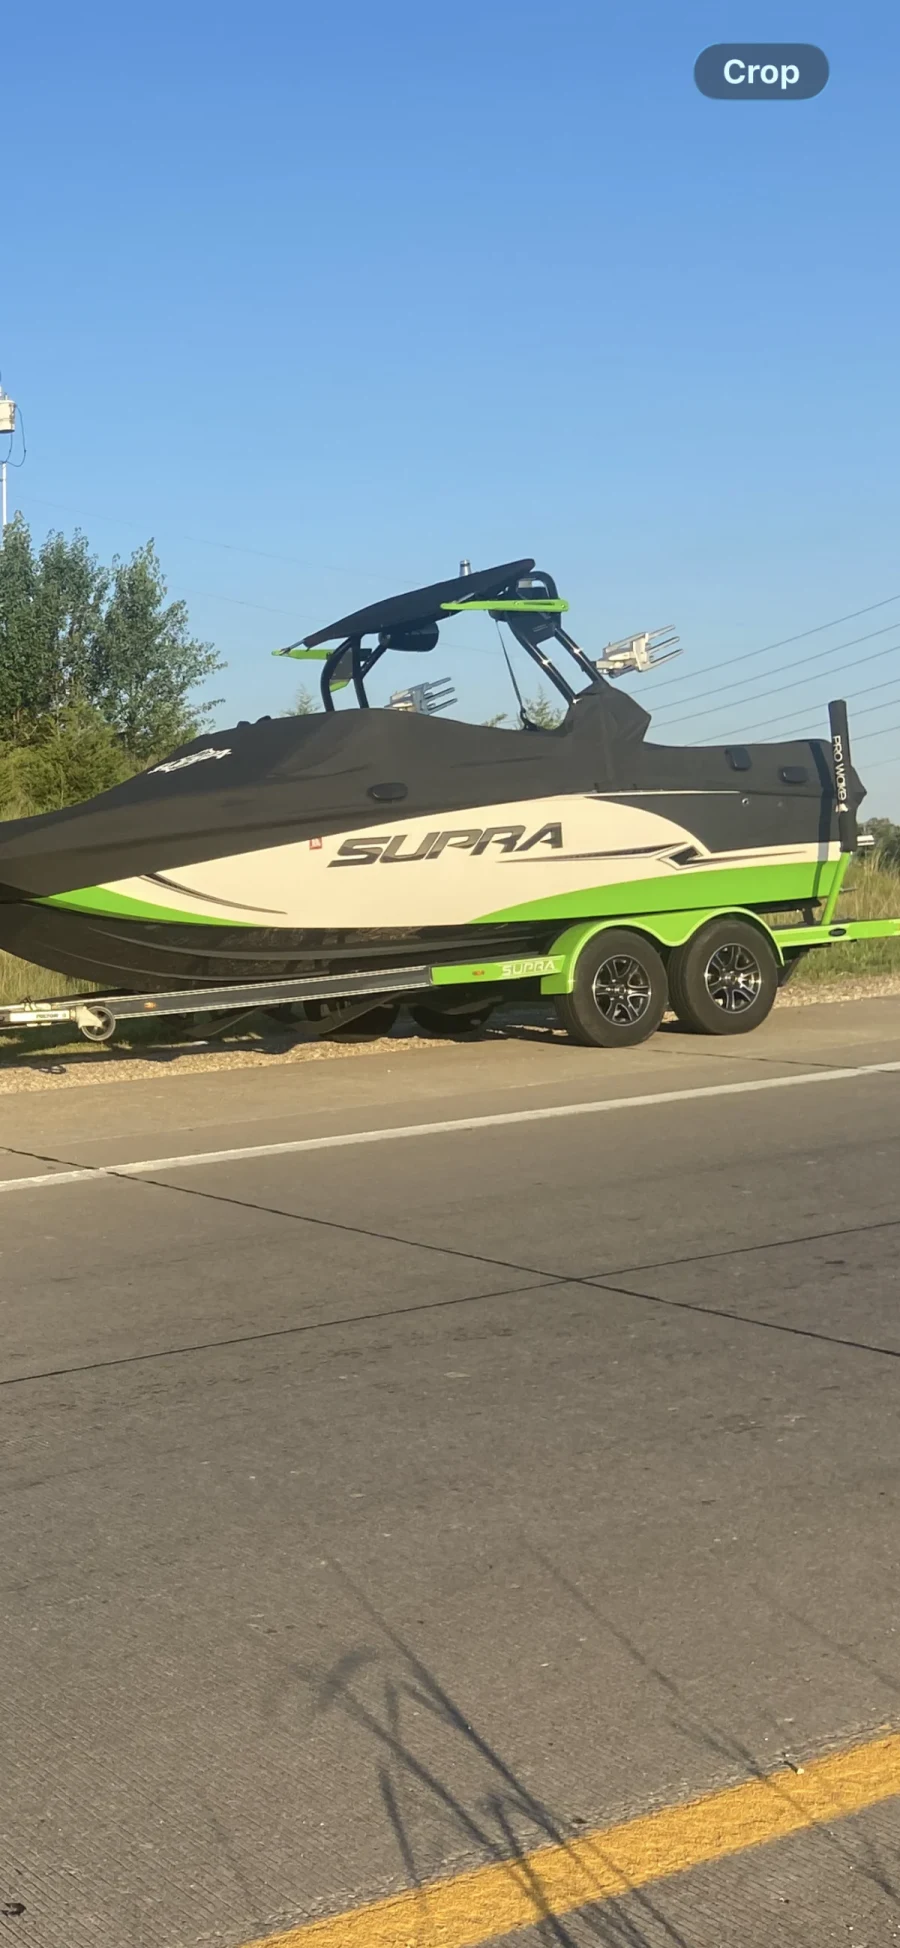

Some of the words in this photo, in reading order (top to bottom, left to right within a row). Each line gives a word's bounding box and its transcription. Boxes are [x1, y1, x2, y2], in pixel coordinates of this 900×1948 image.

[833, 735, 843, 762] PRO
[326, 822, 564, 868] SUPRA
[501, 960, 556, 976] SUPRA
